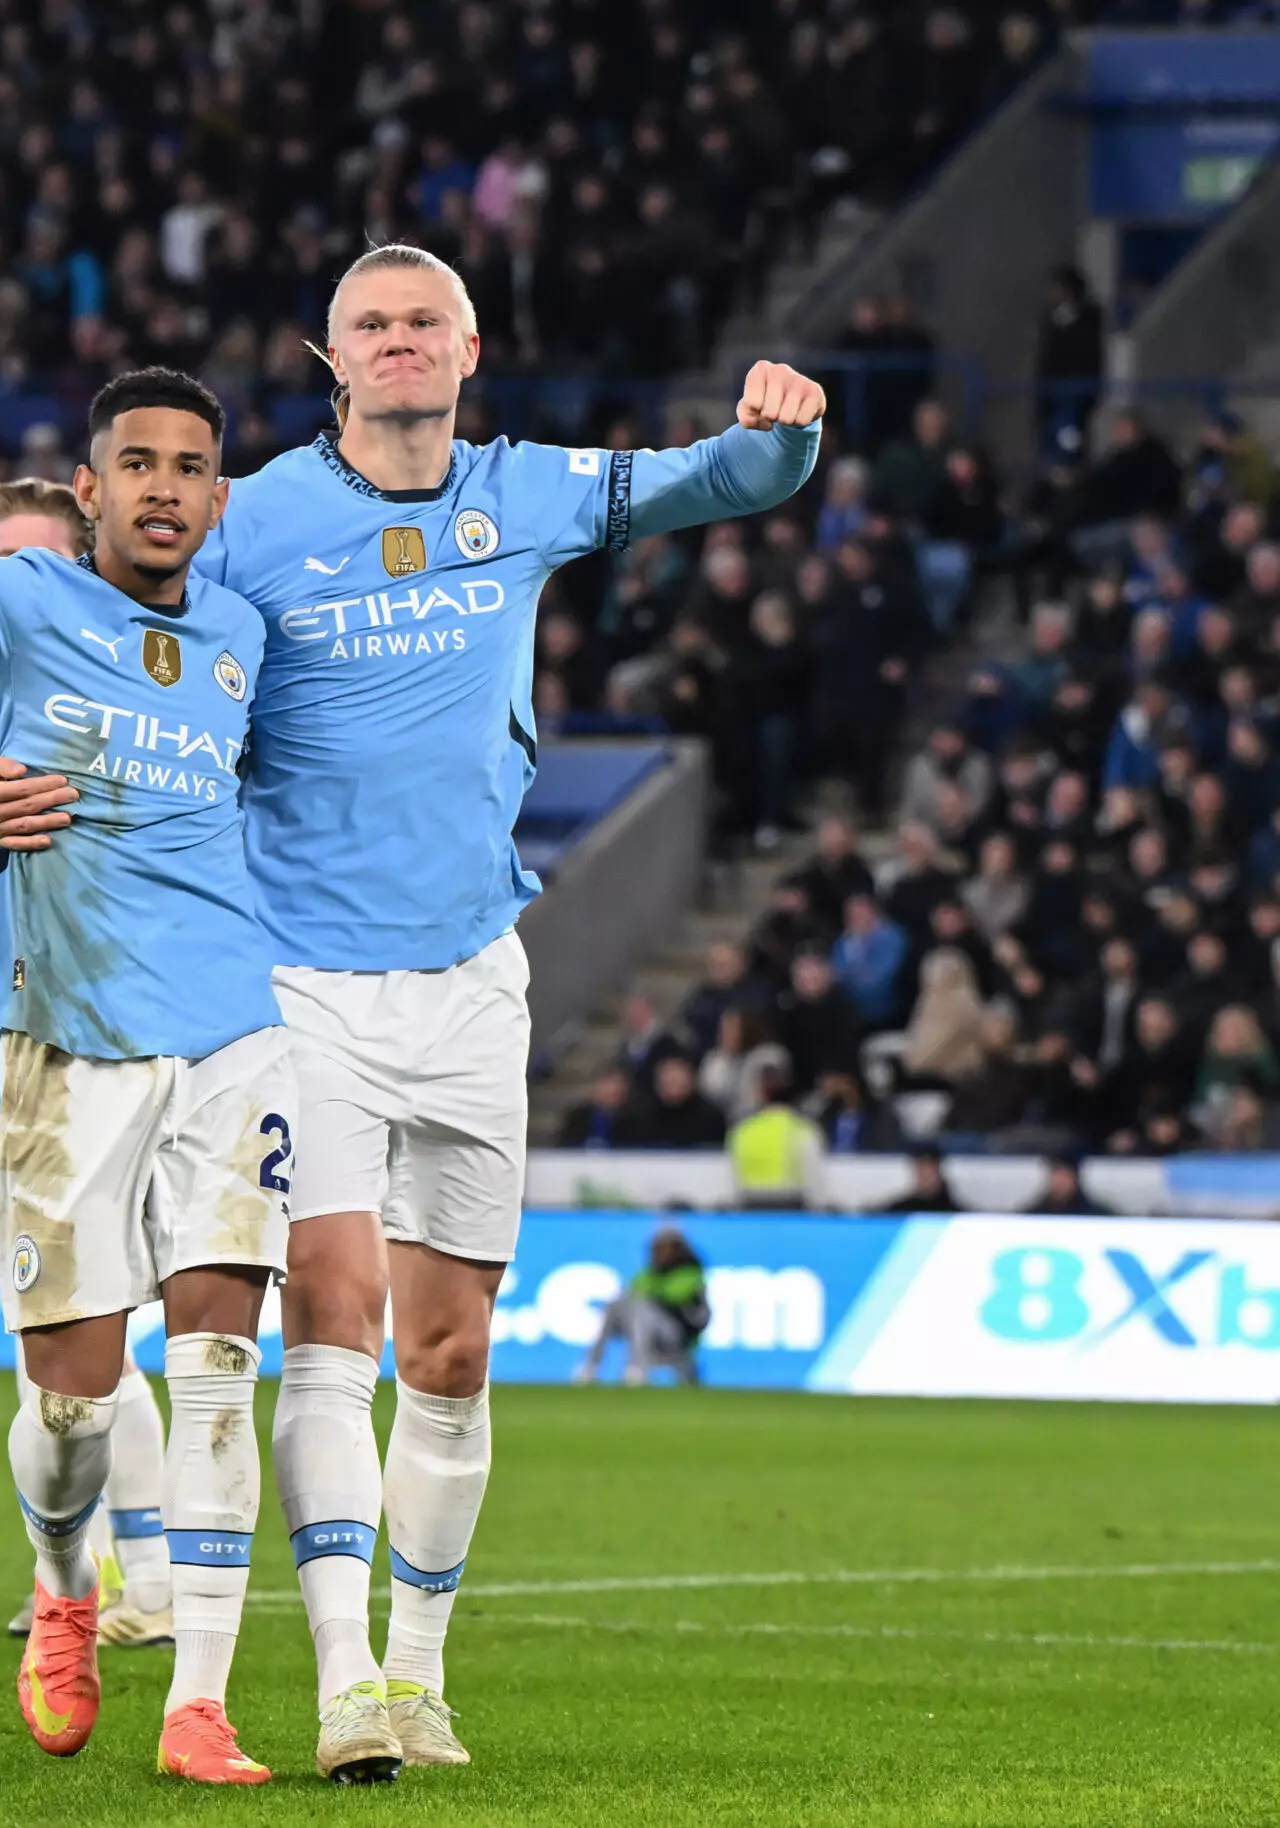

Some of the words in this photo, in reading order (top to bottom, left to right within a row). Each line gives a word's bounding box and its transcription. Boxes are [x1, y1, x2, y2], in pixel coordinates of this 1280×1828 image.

[395, 563, 416, 571] FIFA
[278, 579, 505, 641] ETIHAD
[329, 628, 467, 660] AIRWAYS
[153, 665, 172, 677] FIFA
[88, 752, 217, 801] AIRWAYS
[259, 1112, 295, 1195] 2
[199, 1542, 247, 1555] CITY
[314, 1532, 365, 1545] CITY
